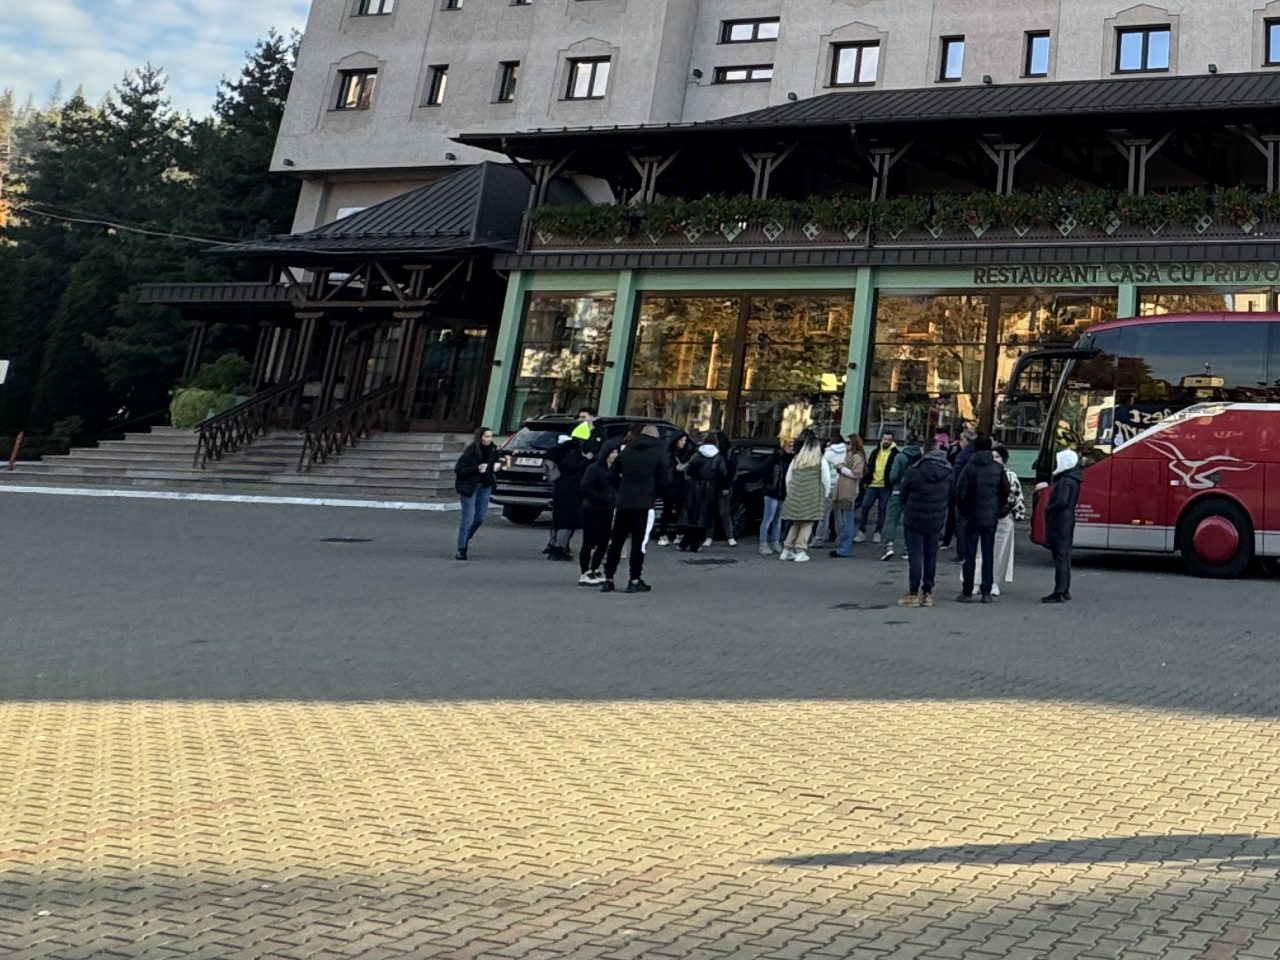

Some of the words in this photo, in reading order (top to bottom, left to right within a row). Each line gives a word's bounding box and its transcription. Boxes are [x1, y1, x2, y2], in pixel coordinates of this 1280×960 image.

[974, 266, 1101, 285] RESTAURANT
[1107, 264, 1160, 283] CASA
[1167, 264, 1195, 283] CU
